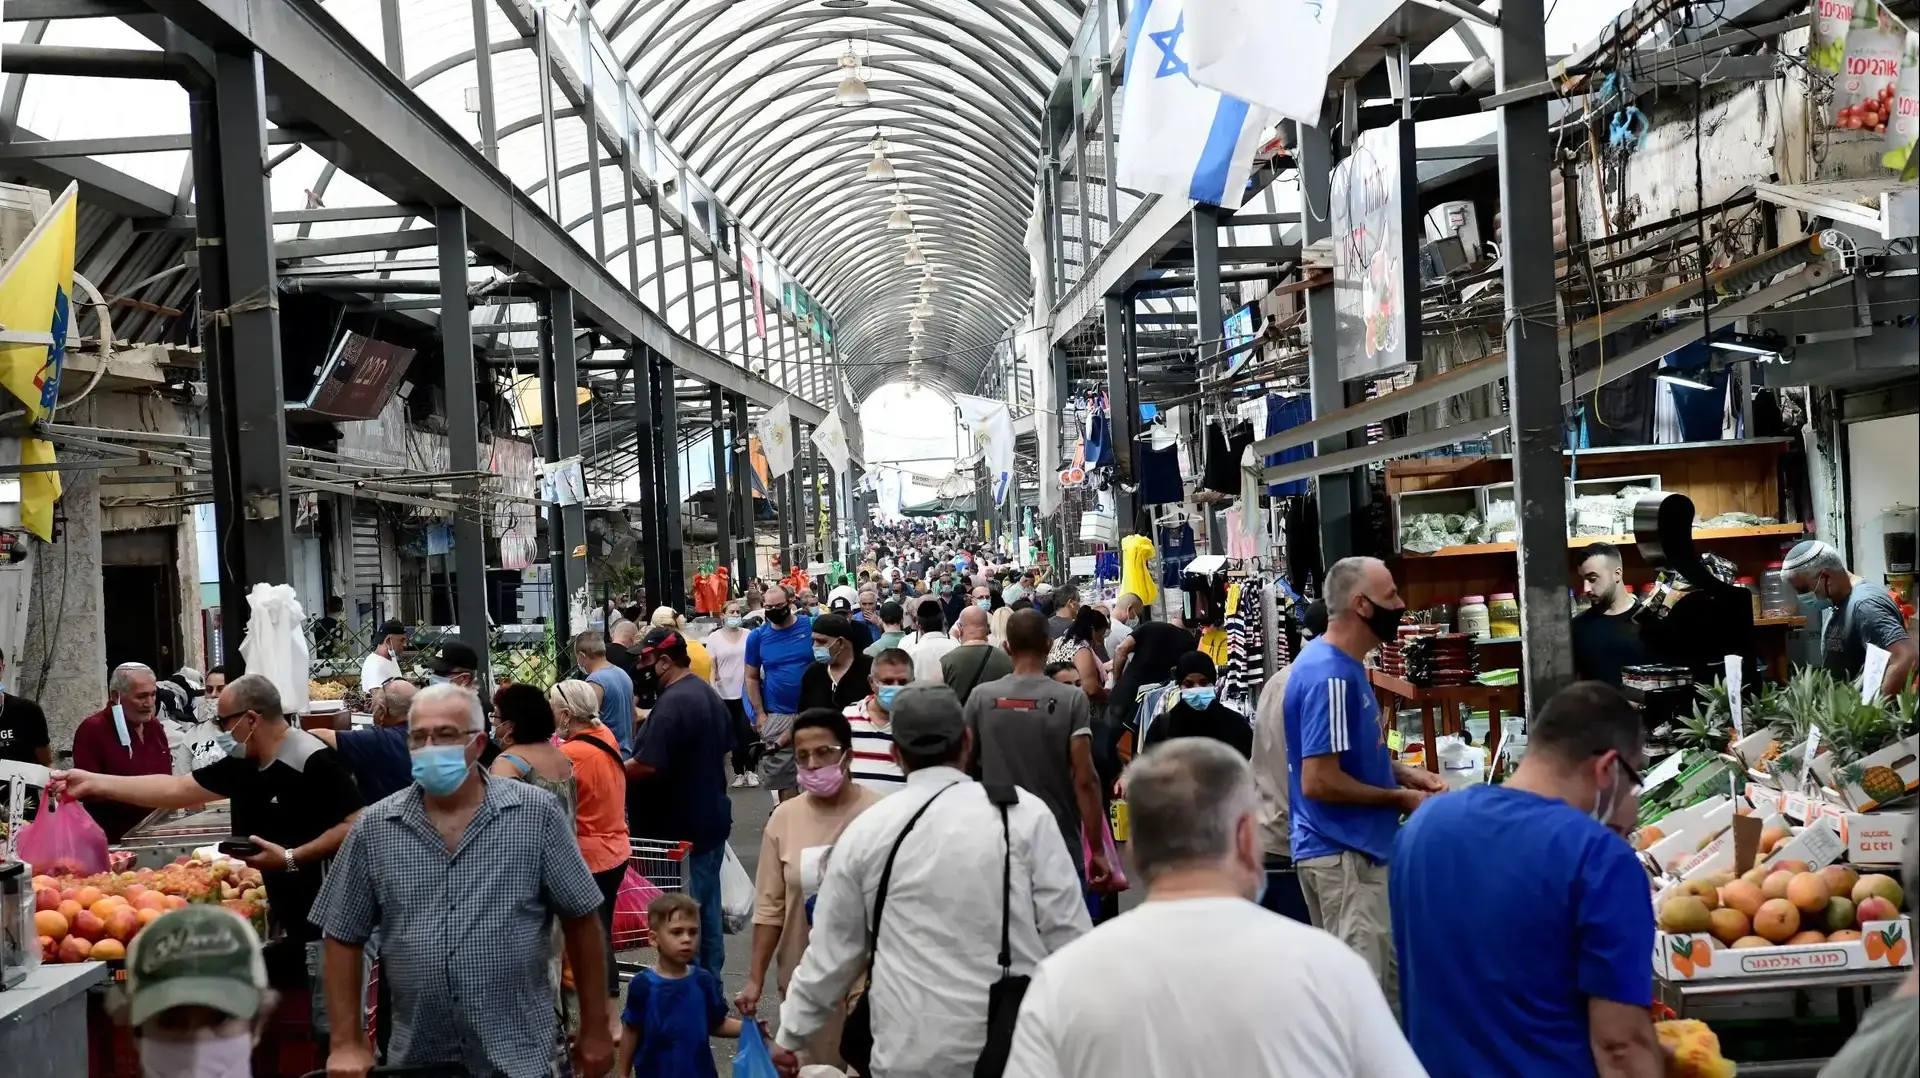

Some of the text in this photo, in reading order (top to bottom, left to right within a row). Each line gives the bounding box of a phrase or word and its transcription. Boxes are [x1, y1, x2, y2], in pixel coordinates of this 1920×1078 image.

[1847, 57, 1898, 77] אוהבים!
[1747, 953, 1839, 969] מנגו אלמגור
